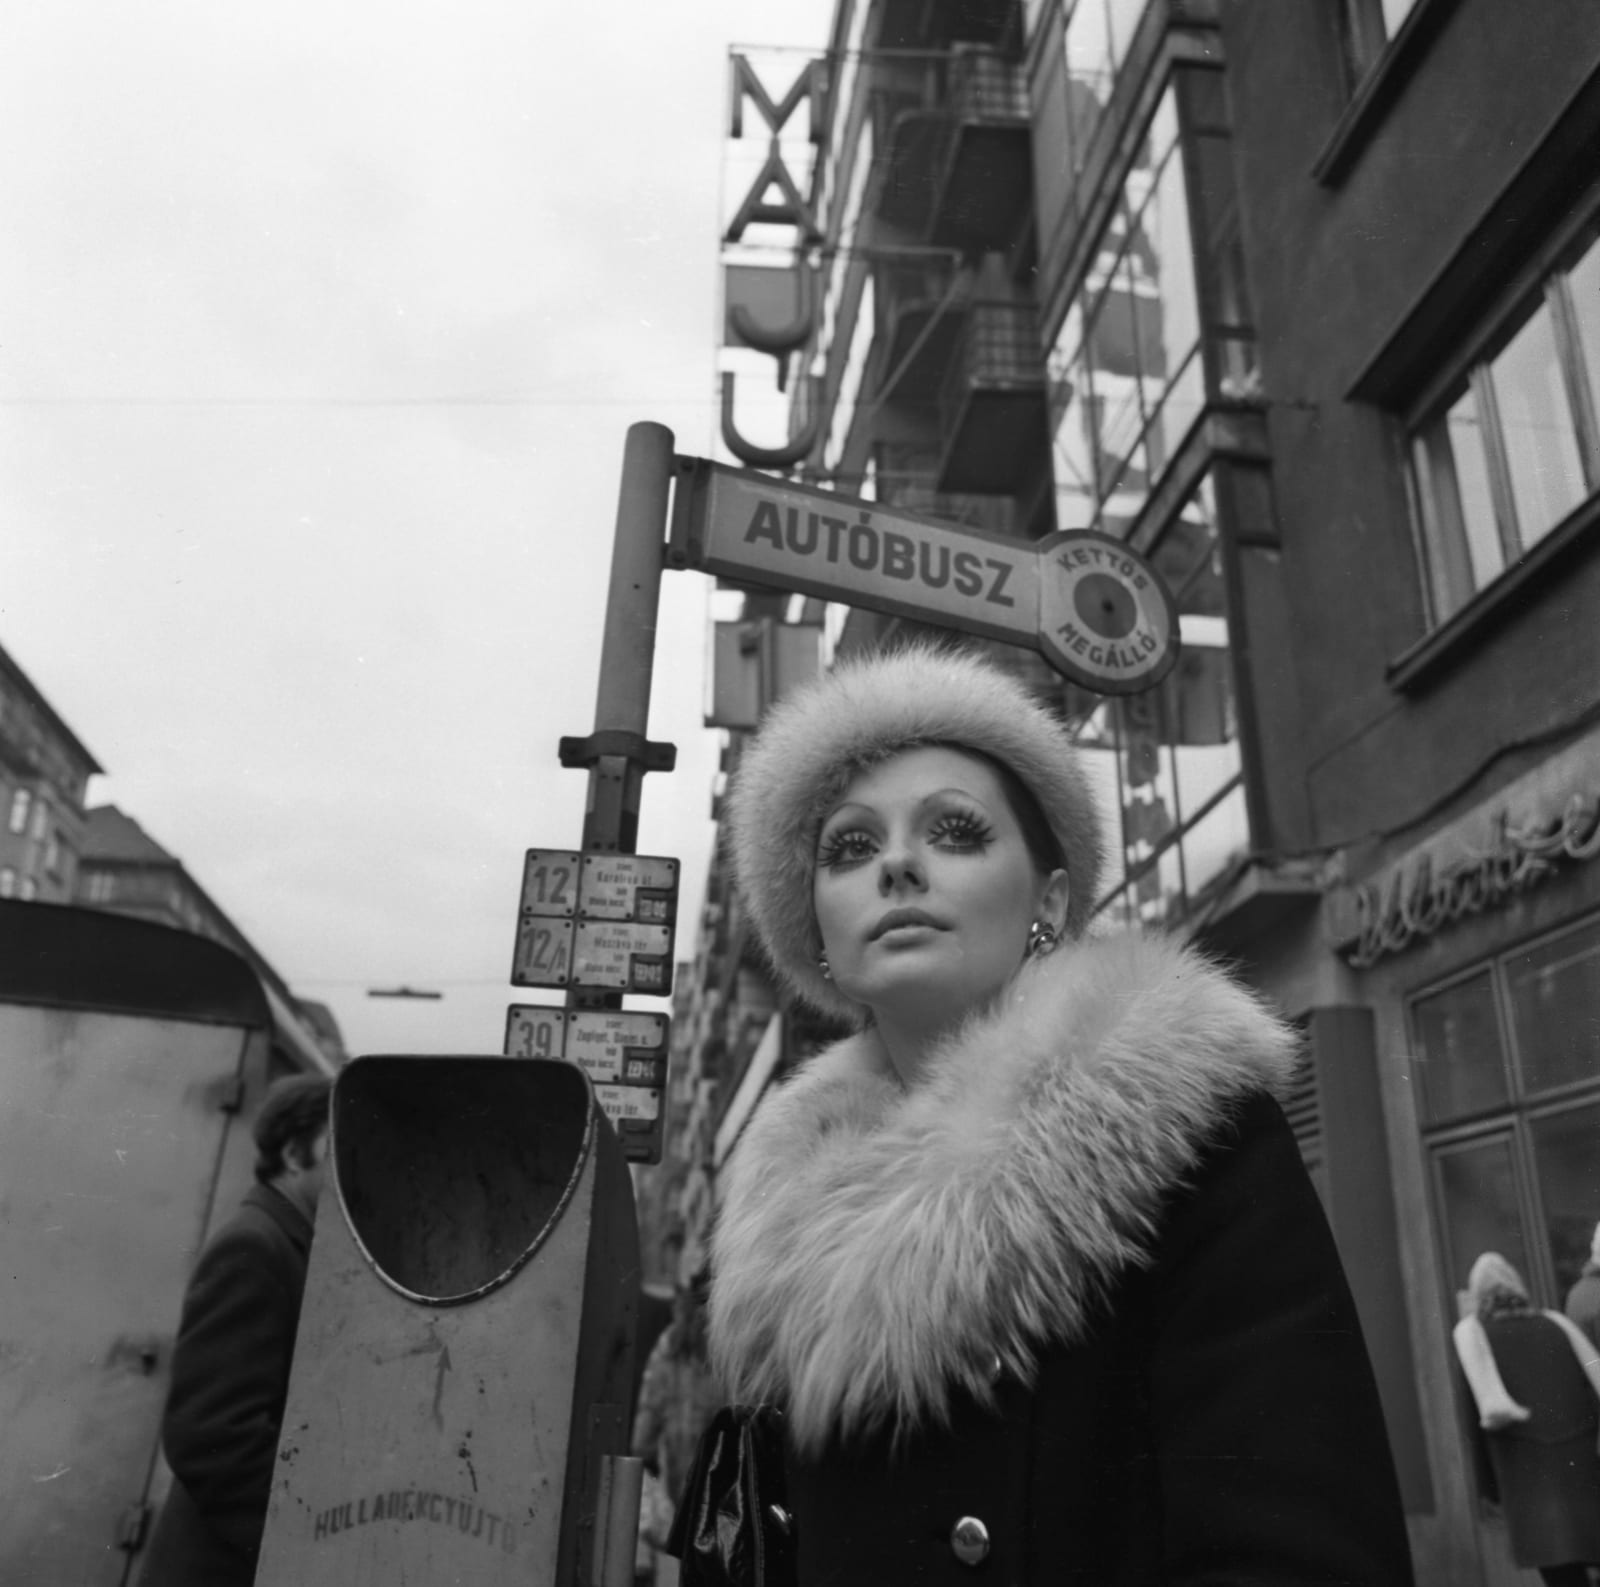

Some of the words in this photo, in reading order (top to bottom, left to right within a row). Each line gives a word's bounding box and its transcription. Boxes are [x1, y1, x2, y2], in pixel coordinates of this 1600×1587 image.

[744, 500, 1014, 607] AUTÓBUSZ
[1056, 622, 1157, 669] MEGÁLLÓ
[533, 865, 571, 904] 12
[518, 1021, 552, 1058] 39
